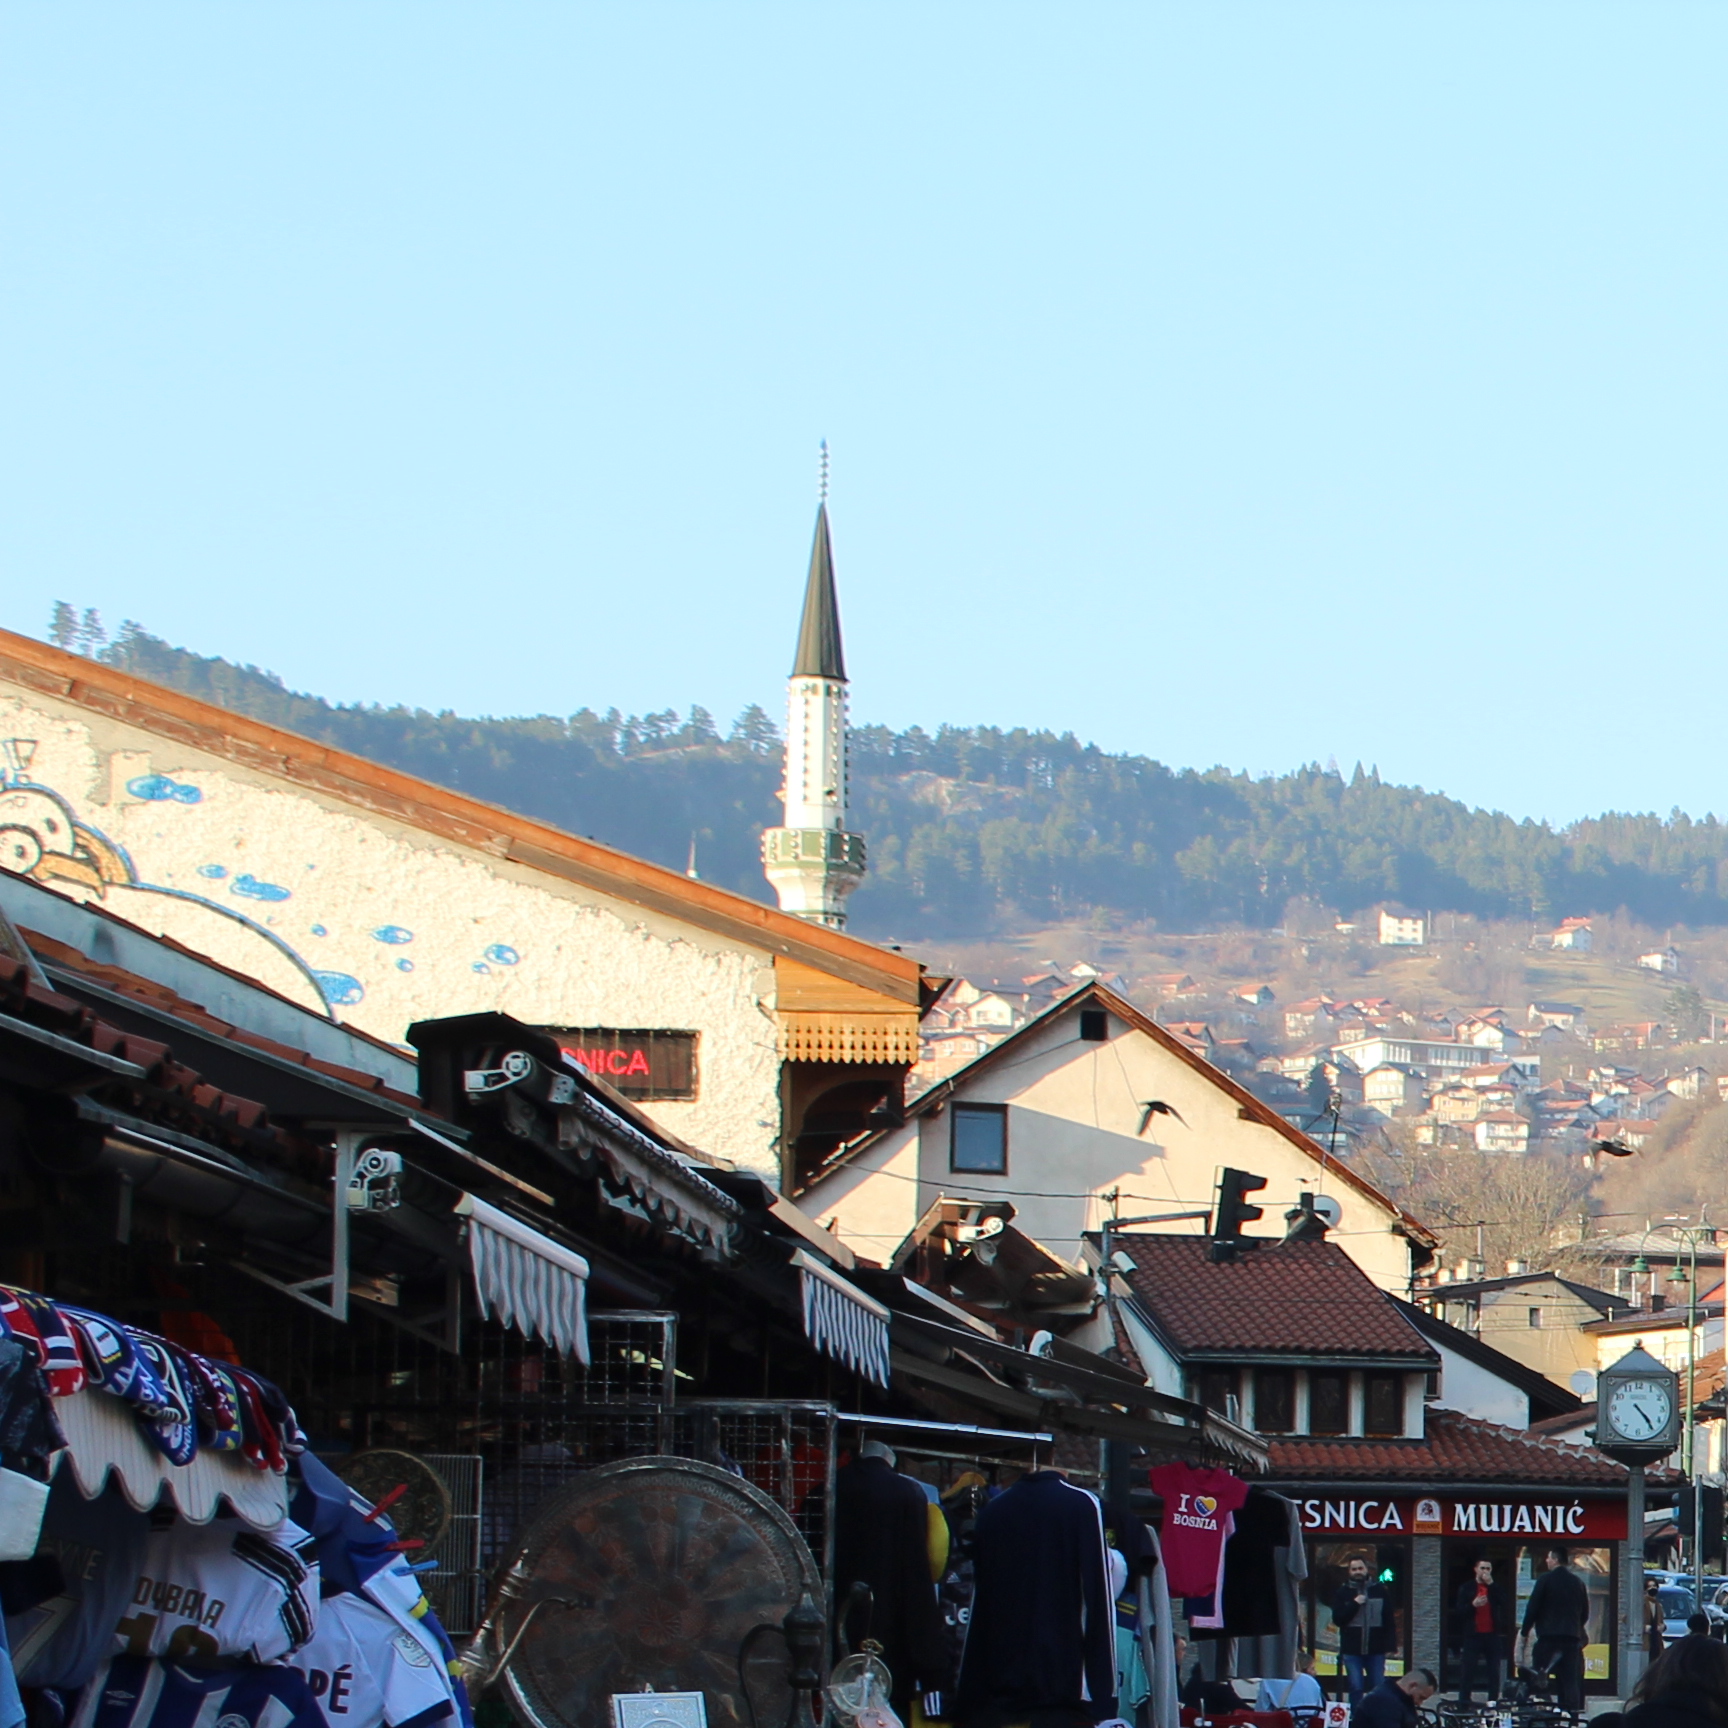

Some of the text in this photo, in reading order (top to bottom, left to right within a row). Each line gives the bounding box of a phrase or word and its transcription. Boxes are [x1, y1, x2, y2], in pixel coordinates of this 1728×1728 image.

[1178, 1493, 1188, 1513] I
[1453, 1499, 1585, 1535] MUJANIĆ
[1173, 1512, 1219, 1532] BOSNIA
[133, 1576, 226, 1628] DYBALA
